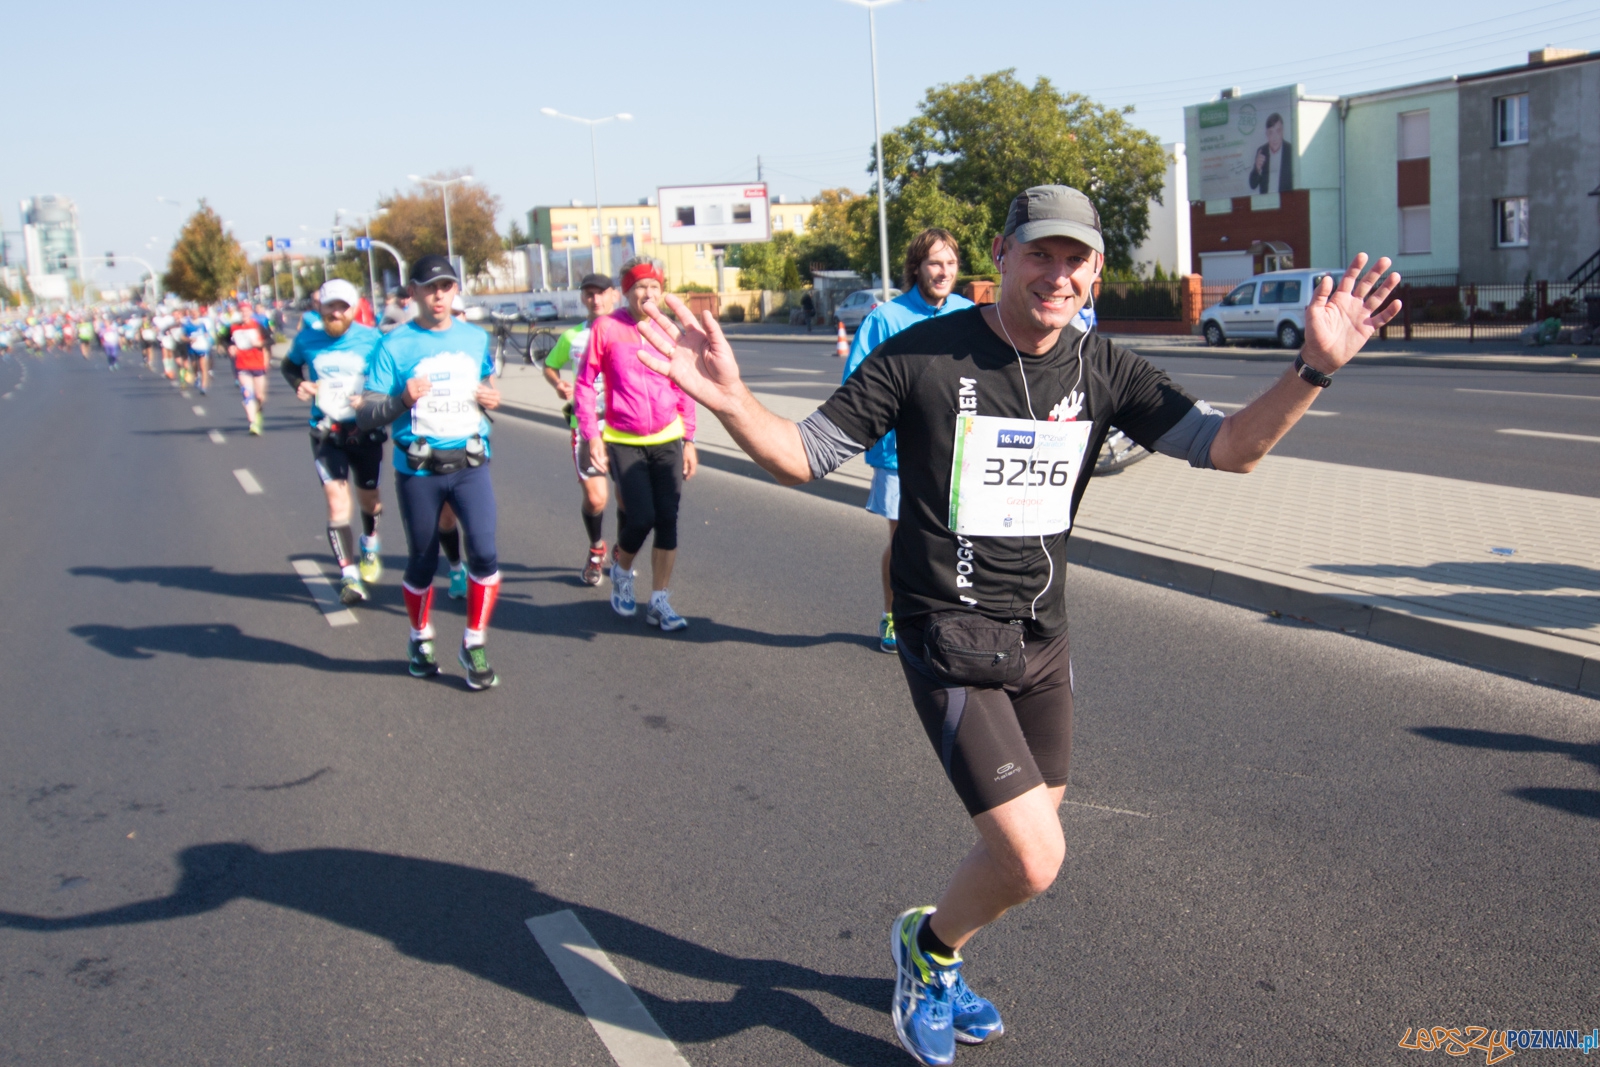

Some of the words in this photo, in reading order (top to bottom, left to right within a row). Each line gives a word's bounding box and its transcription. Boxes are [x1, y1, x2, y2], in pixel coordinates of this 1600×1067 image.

[427, 401, 469, 413] 5436
[1000, 434, 1012, 444] 16.
[1014, 435, 1033, 445] PKO
[983, 458, 1069, 486] 3256
[1006, 497, 1044, 507] Grzegorz
